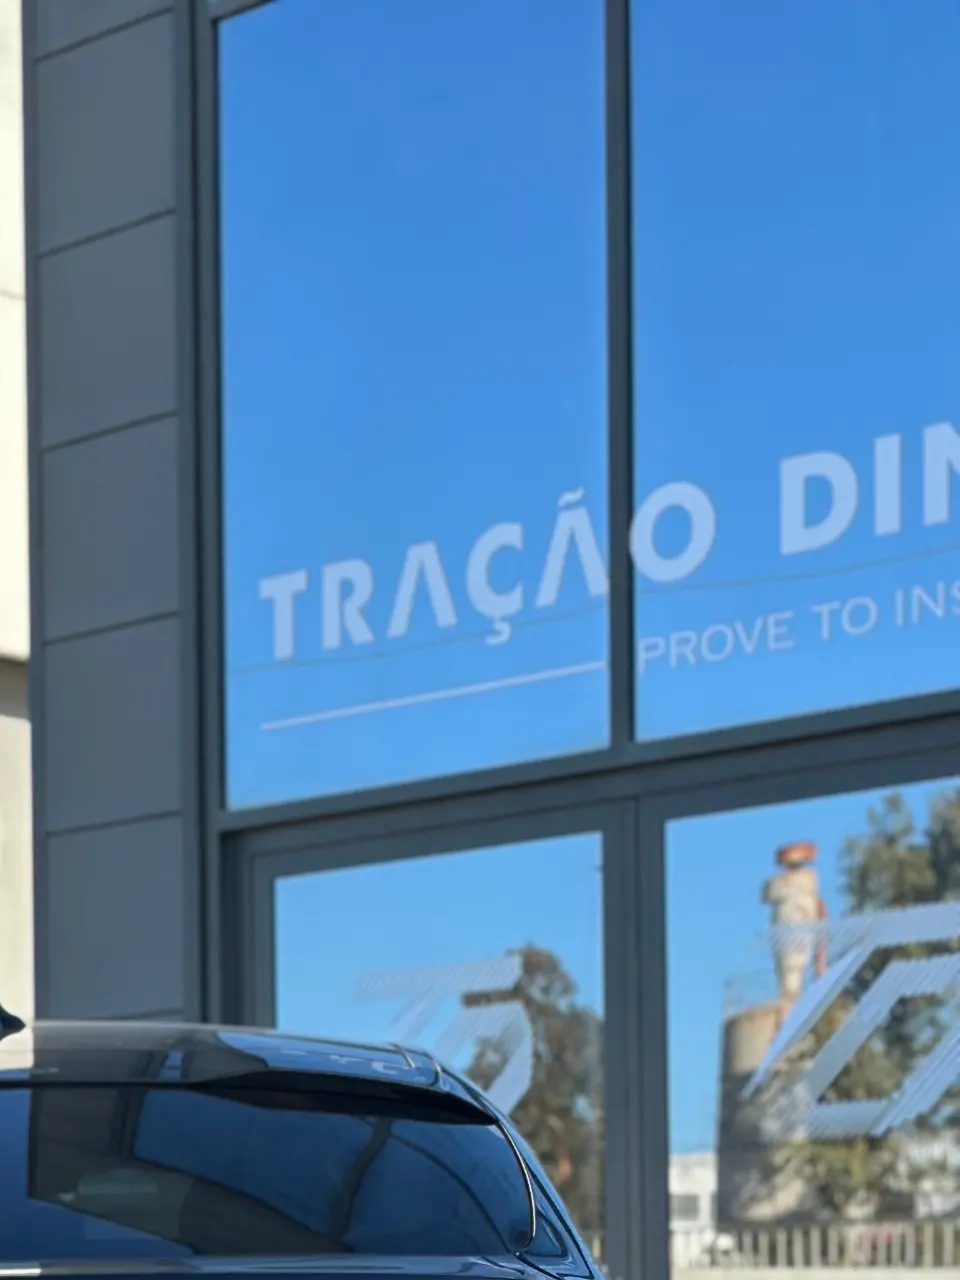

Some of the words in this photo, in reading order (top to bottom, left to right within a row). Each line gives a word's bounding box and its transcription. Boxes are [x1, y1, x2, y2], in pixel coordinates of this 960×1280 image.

[258, 480, 717, 662] TRAÇÃO
[638, 609, 797, 675] PROVE
[811, 595, 879, 643] TO
